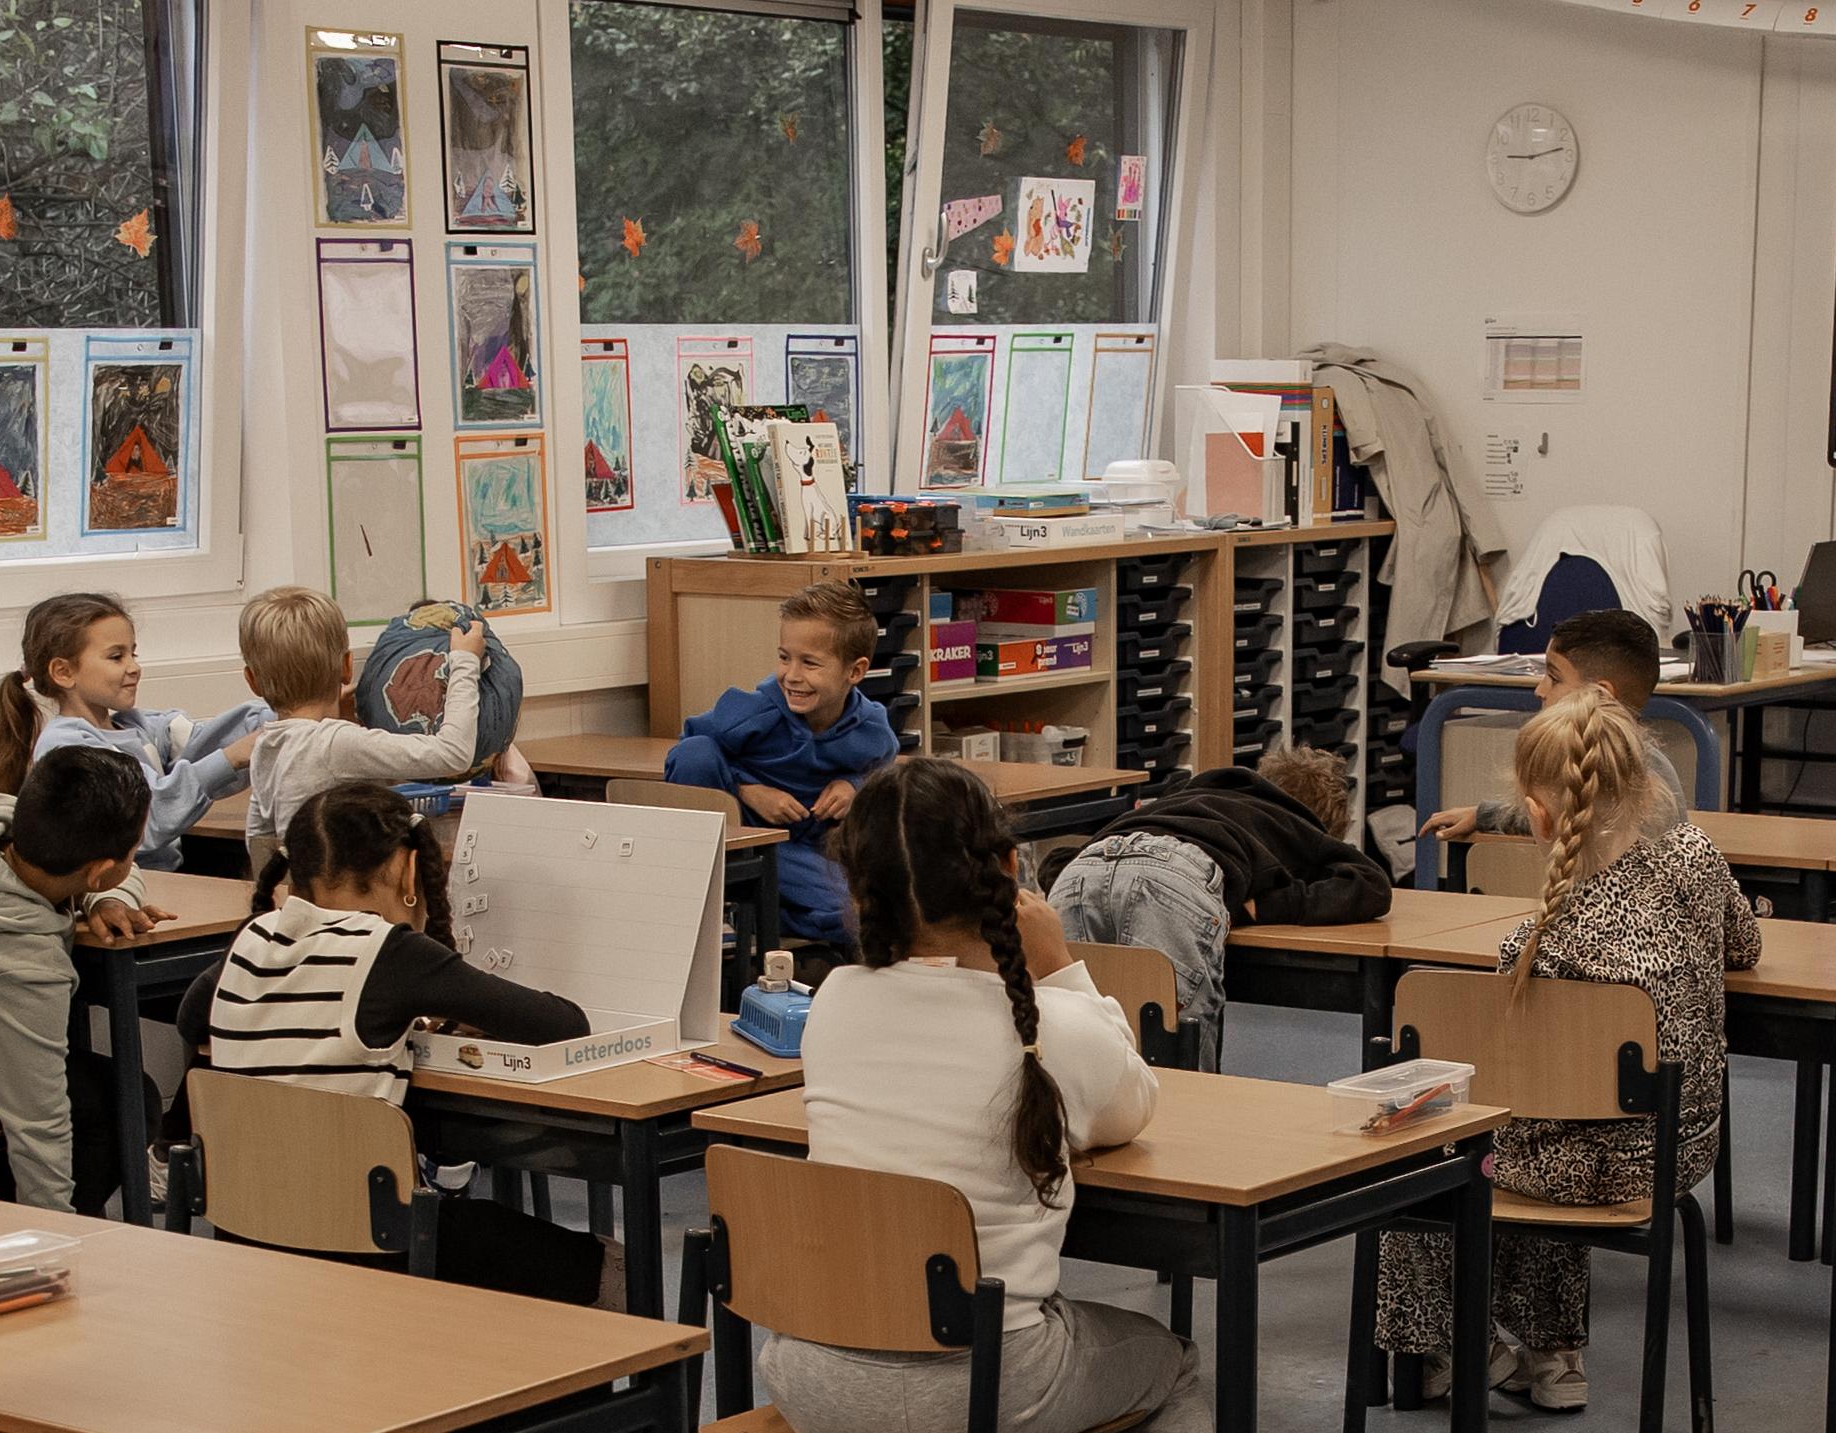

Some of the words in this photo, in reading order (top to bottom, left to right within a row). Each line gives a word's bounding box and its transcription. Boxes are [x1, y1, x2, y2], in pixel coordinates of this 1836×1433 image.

[1741, 4, 1755, 17] 7
[1805, 8, 1818, 22] 8
[1020, 525, 1047, 540] Lijn3
[1062, 523, 1115, 538] Wandkaarten
[930, 645, 971, 663] KRAKER
[565, 1034, 653, 1066] Letterdoos
[503, 1053, 532, 1072] Lijn3
